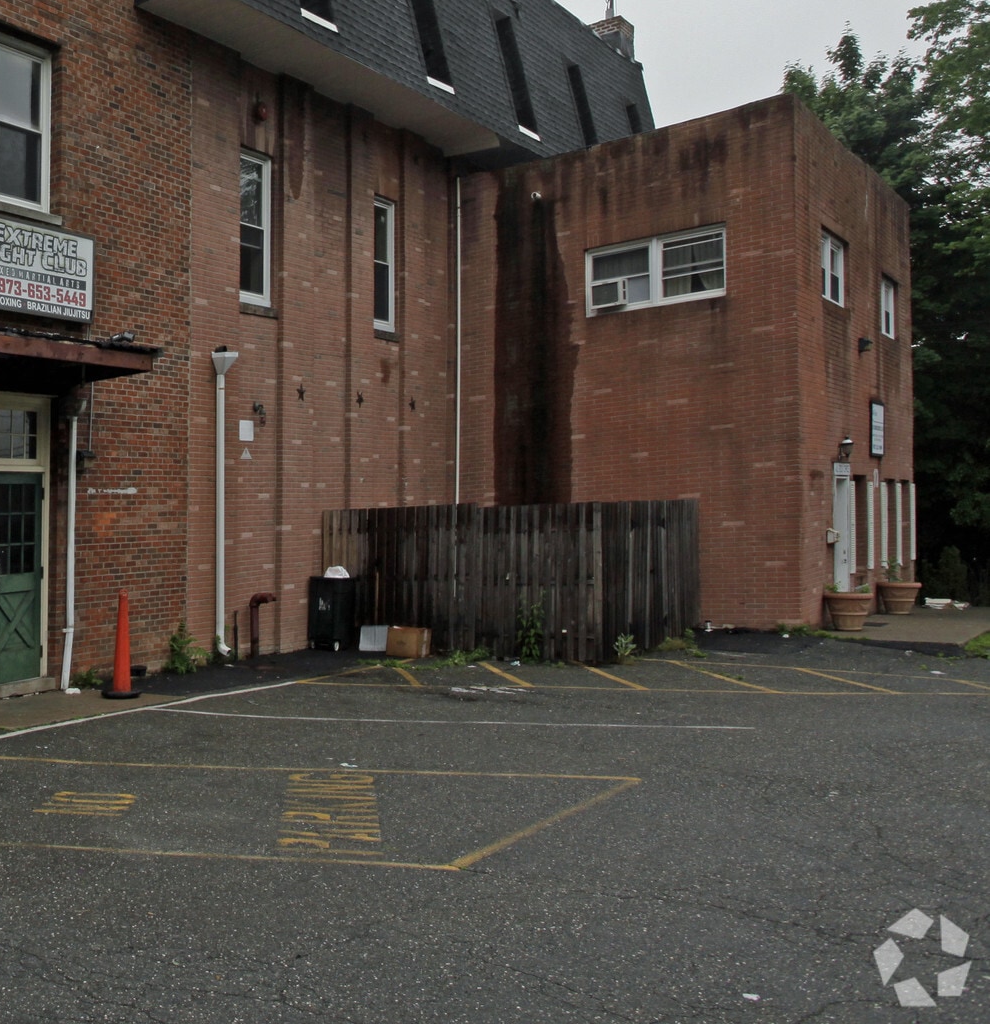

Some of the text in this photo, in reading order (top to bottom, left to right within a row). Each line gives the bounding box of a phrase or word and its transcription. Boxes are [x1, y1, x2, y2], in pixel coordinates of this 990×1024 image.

[41, 249, 88, 277] CLUB
[19, 271, 57, 285] MARTIAL
[59, 278, 80, 289] ARTS
[26, 300, 62, 315] BRAZILIAN
[63, 306, 91, 320] JIUJITSU
